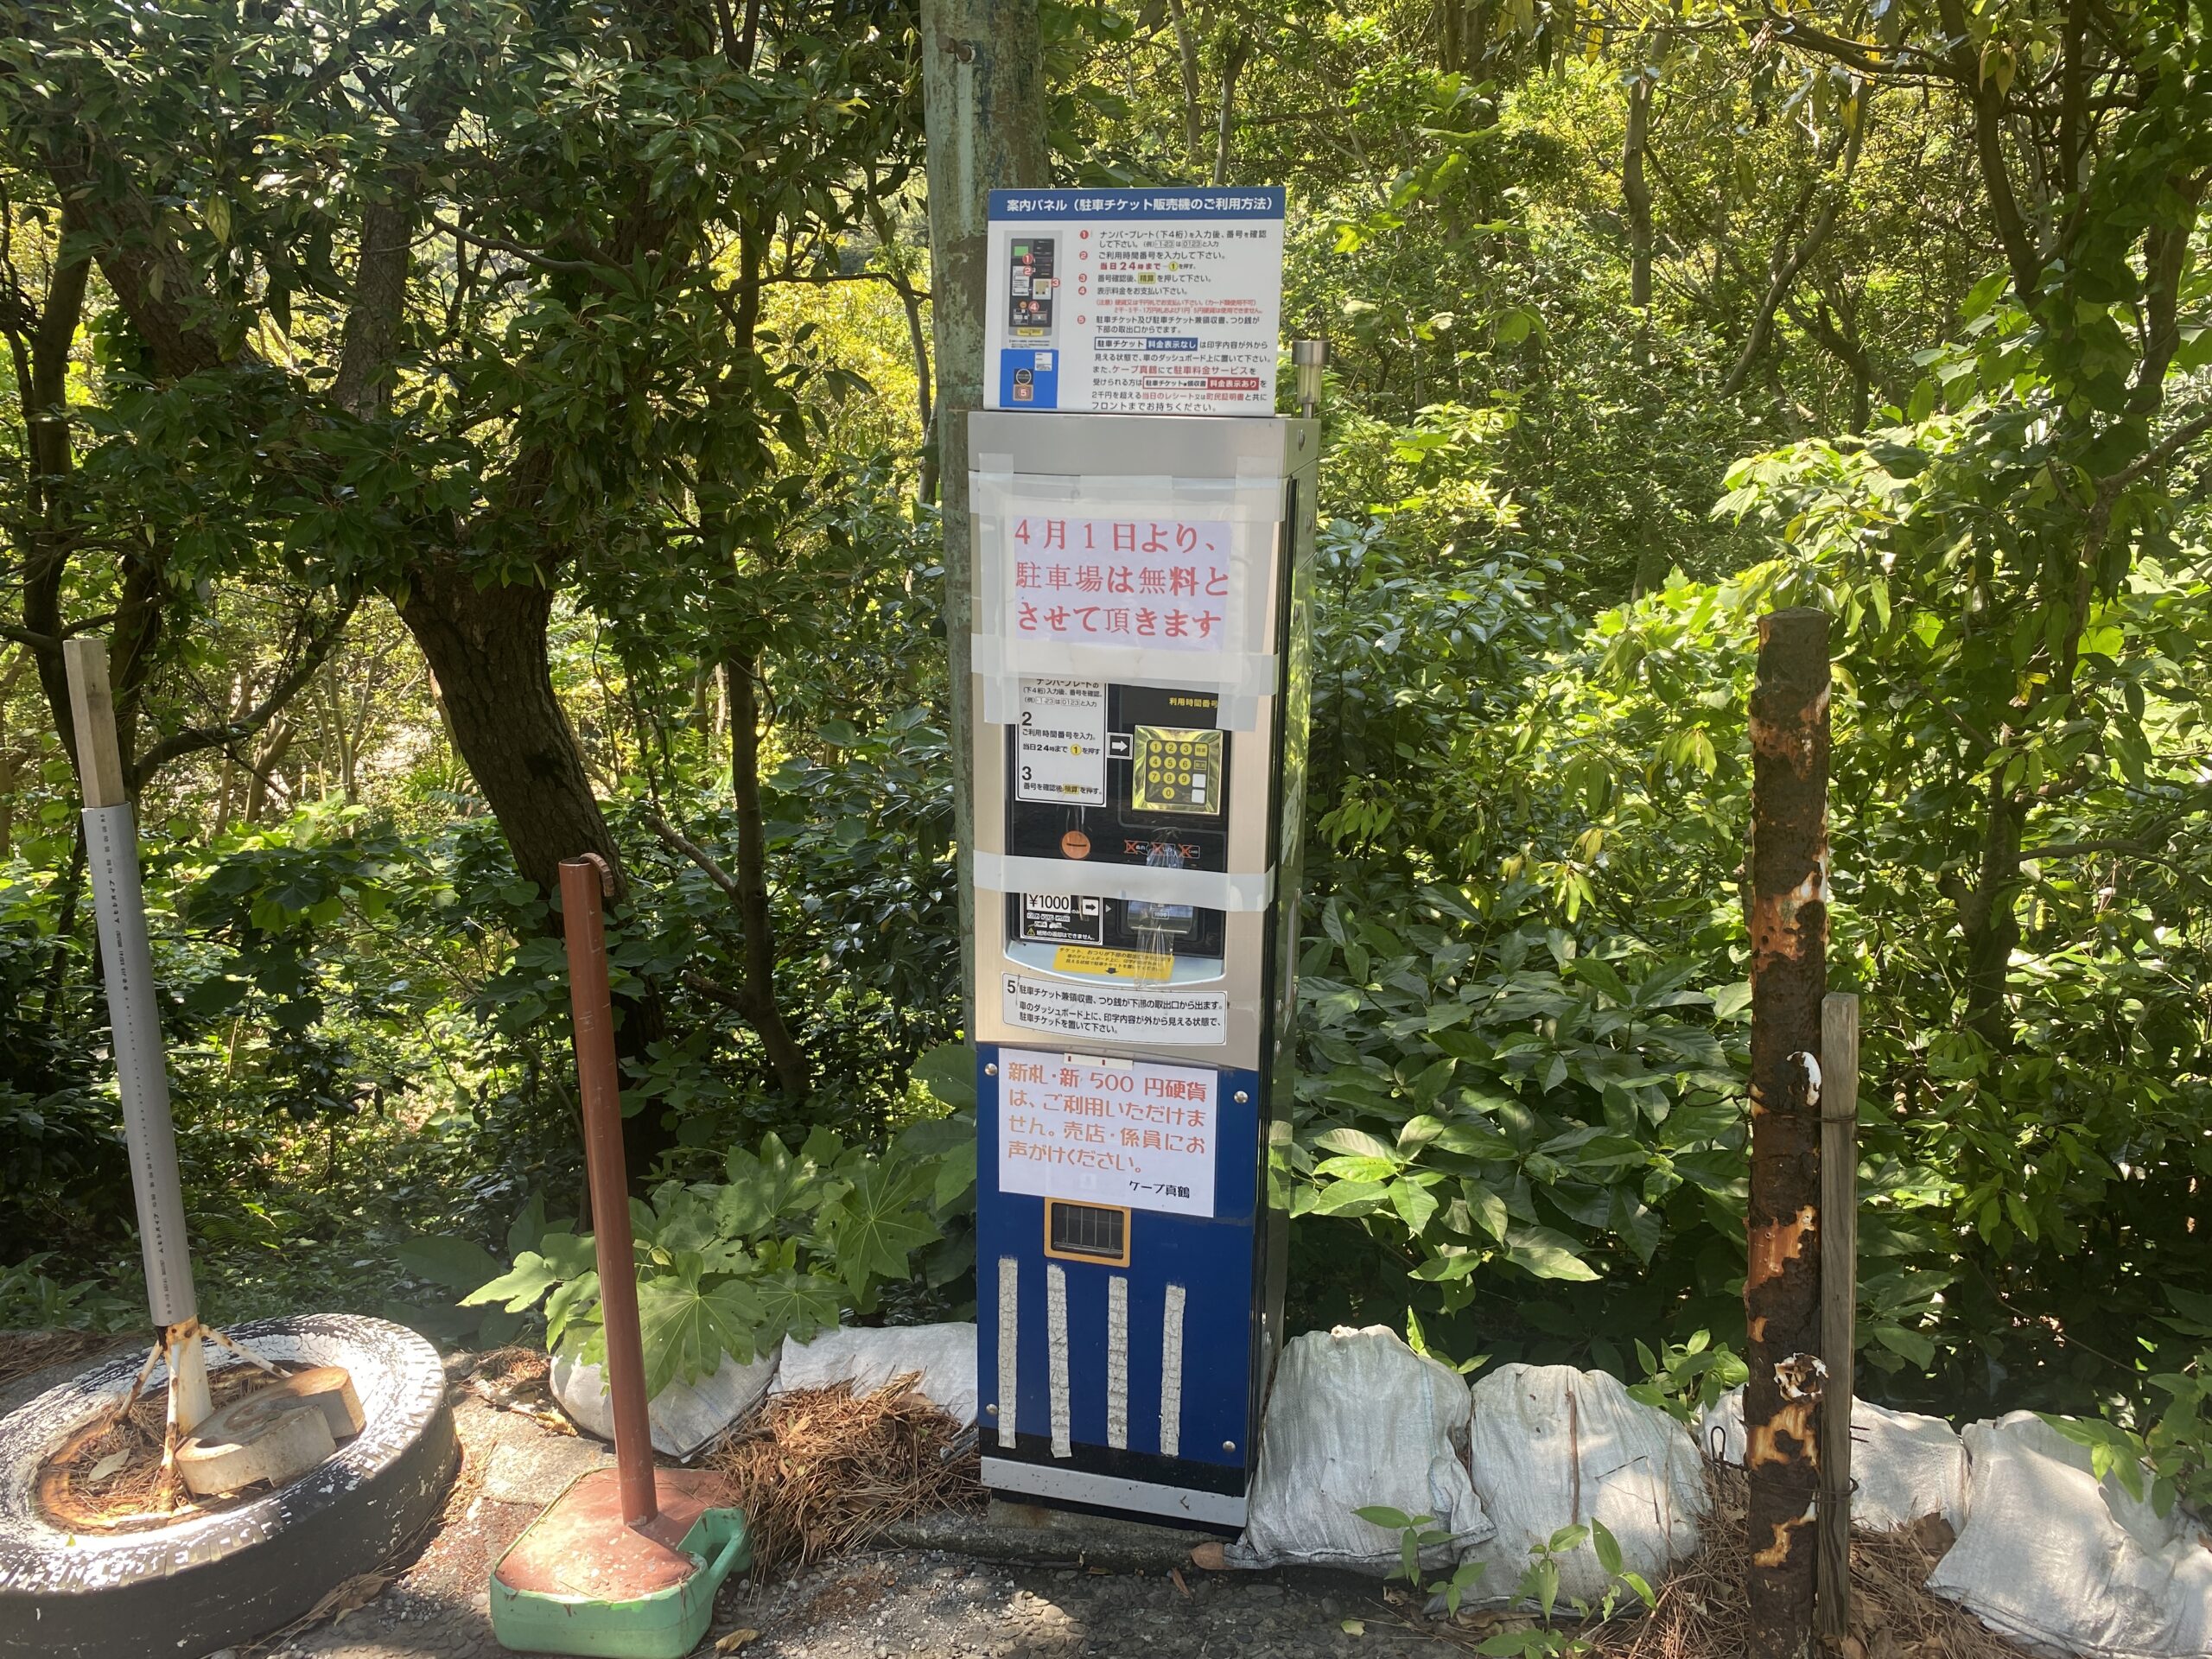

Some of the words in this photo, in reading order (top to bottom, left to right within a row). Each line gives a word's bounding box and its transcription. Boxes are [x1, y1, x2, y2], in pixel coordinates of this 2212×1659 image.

[1092, 402, 1216, 411] フロントまでお持ちください。
[1015, 562, 1230, 597] 駐車場は無料と
[1018, 602, 1222, 639] させて頂きます
[1021, 711, 1032, 726] 2
[1021, 766, 1032, 780] 3
[1007, 980, 1016, 994] 5
[1008, 1089, 1206, 1128] は、ご利用いただけま
[1129, 1180, 1191, 1199] ケープ真鶴
